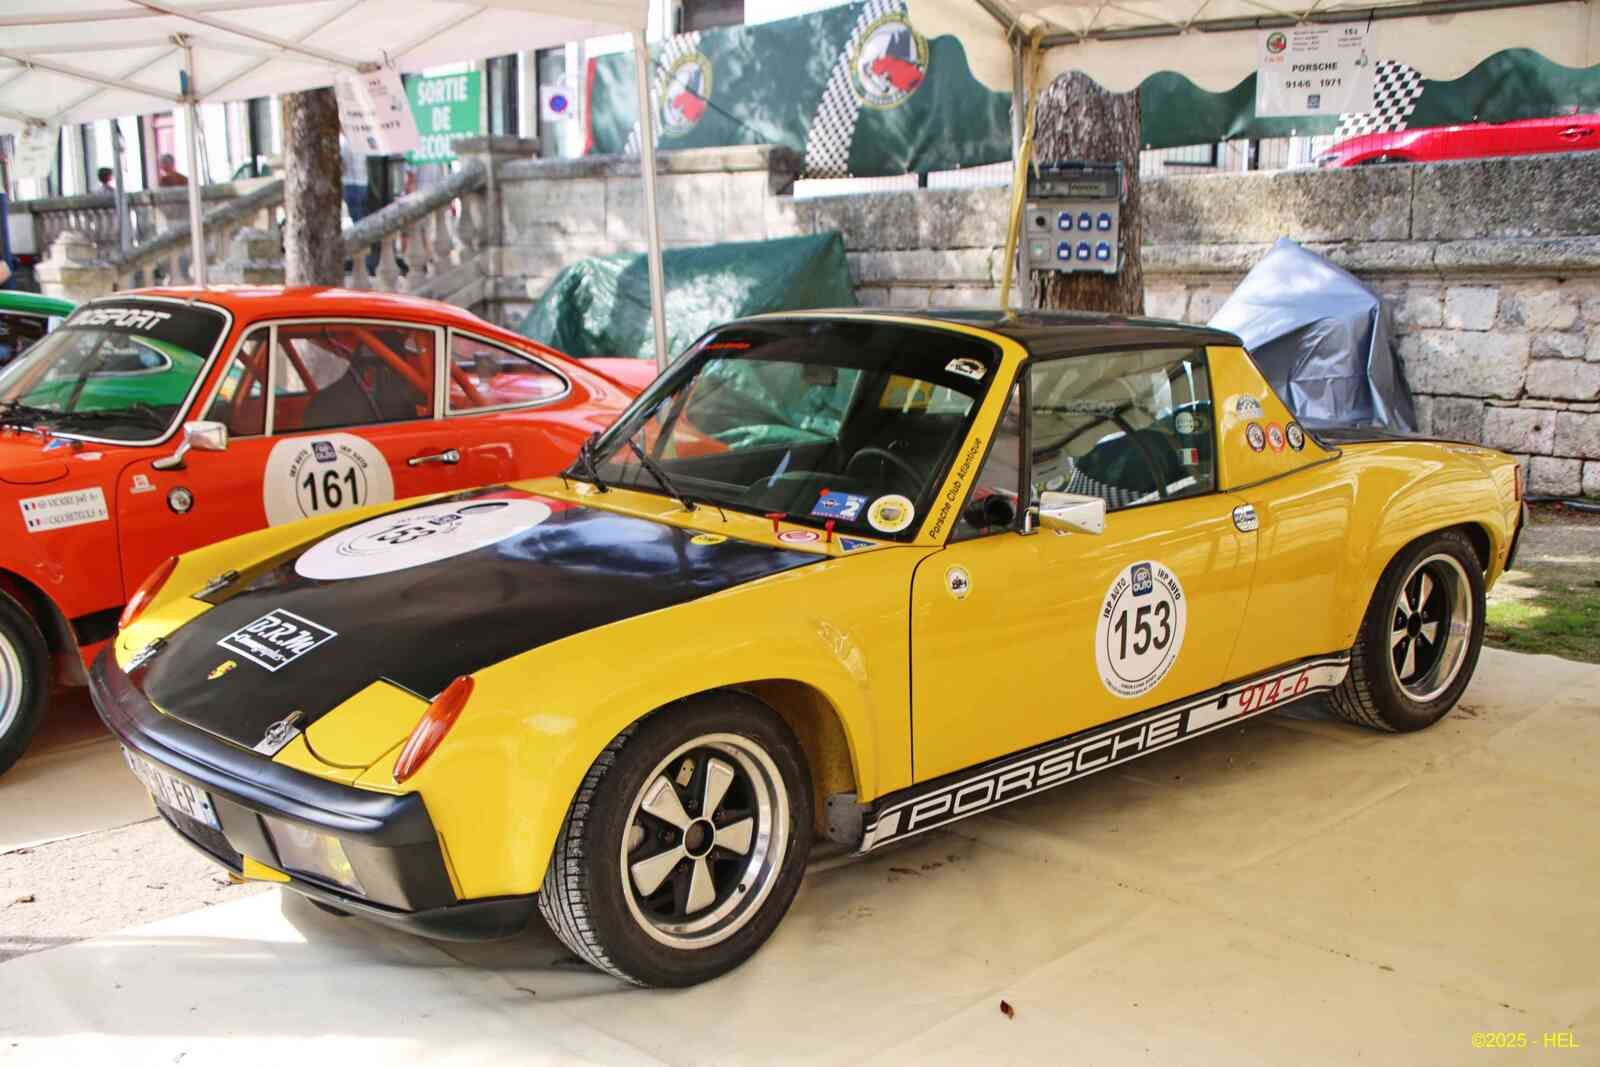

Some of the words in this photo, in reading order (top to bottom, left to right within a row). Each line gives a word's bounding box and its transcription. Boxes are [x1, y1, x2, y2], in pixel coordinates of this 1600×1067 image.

[1291, 62, 1338, 72] PORSCHE
[1320, 78, 1342, 88] 1971
[417, 76, 469, 105] SORTIE
[431, 106, 452, 132] DE
[303, 467, 358, 511] 161
[929, 502, 952, 540] Porsche
[946, 480, 961, 502] Club
[1103, 601, 1113, 619] IRP
[1111, 577, 1126, 601] AUTO
[1157, 567, 1169, 582] IRP
[1167, 577, 1181, 600] AUTO
[1114, 600, 1171, 660] 153
[1238, 671, 1309, 713] 914-6
[908, 713, 1182, 831] PORSCHE
